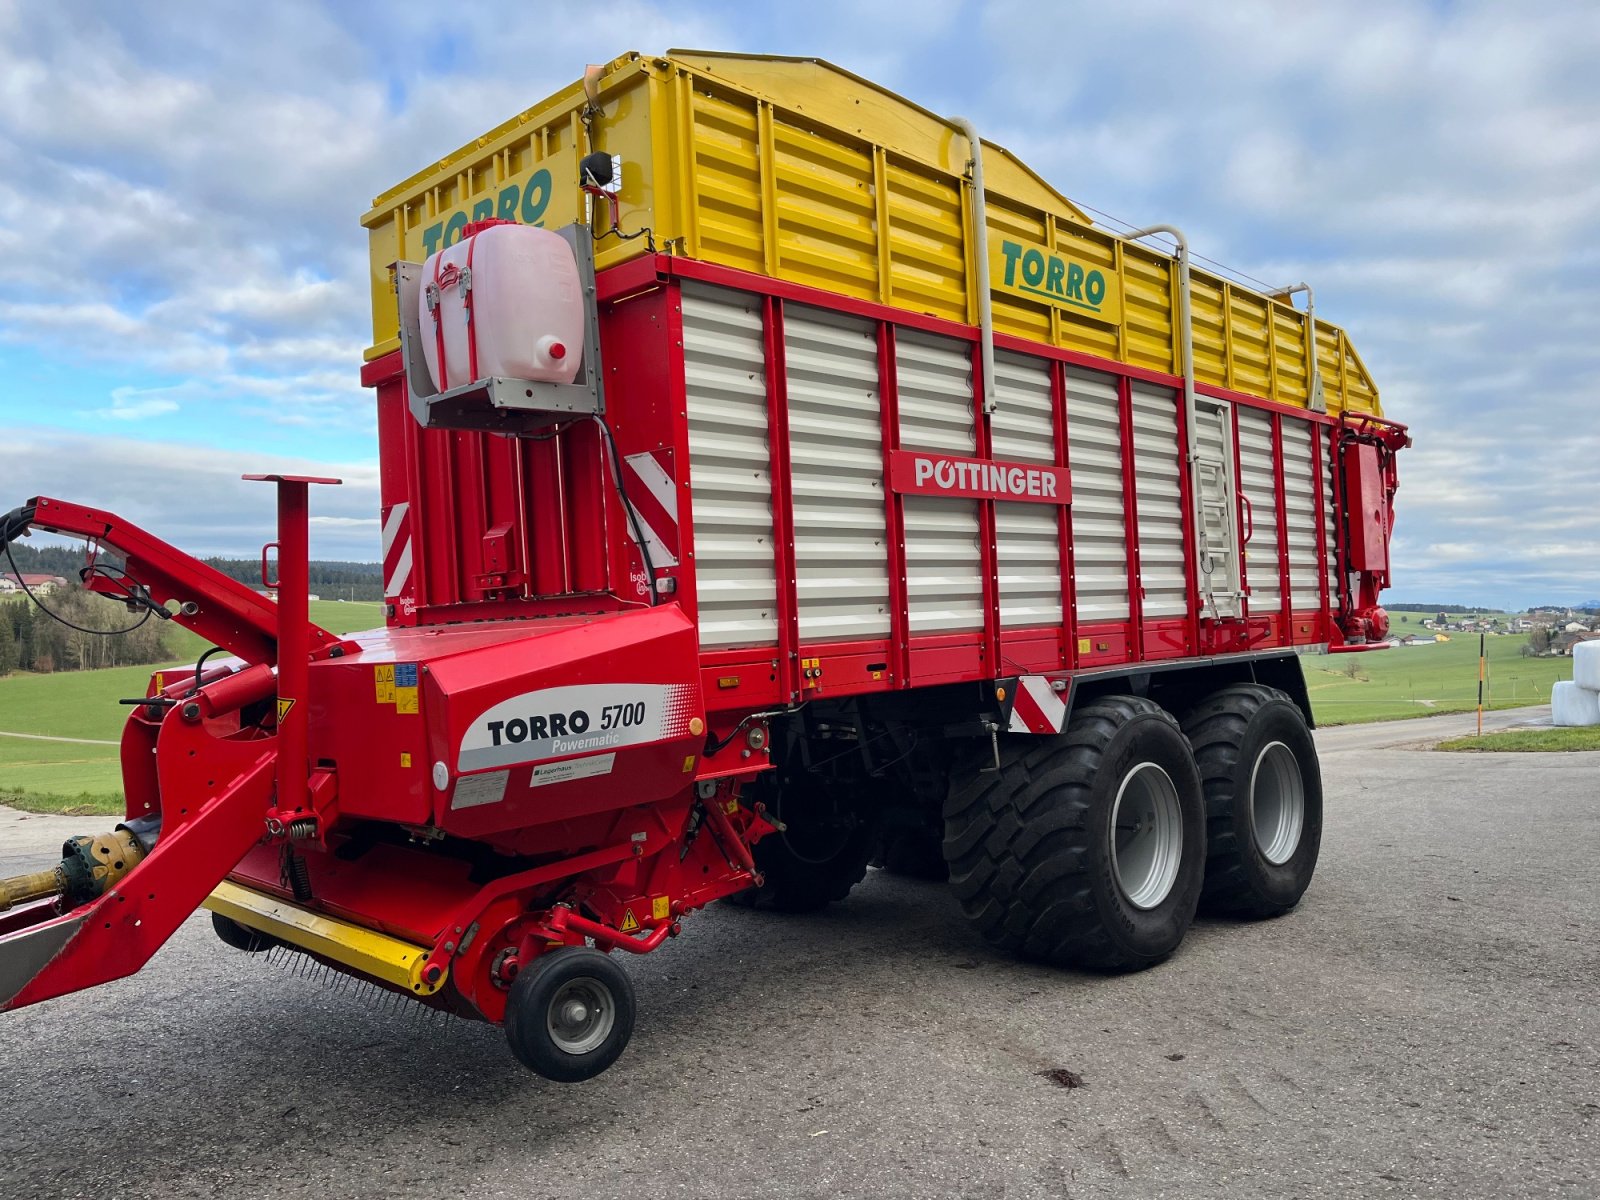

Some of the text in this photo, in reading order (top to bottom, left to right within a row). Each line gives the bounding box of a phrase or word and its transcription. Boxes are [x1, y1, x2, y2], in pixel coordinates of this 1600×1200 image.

[1002, 240, 1105, 305] TORRO
[488, 701, 646, 746] TORRO 5700
[551, 731, 620, 753] Powermatic
